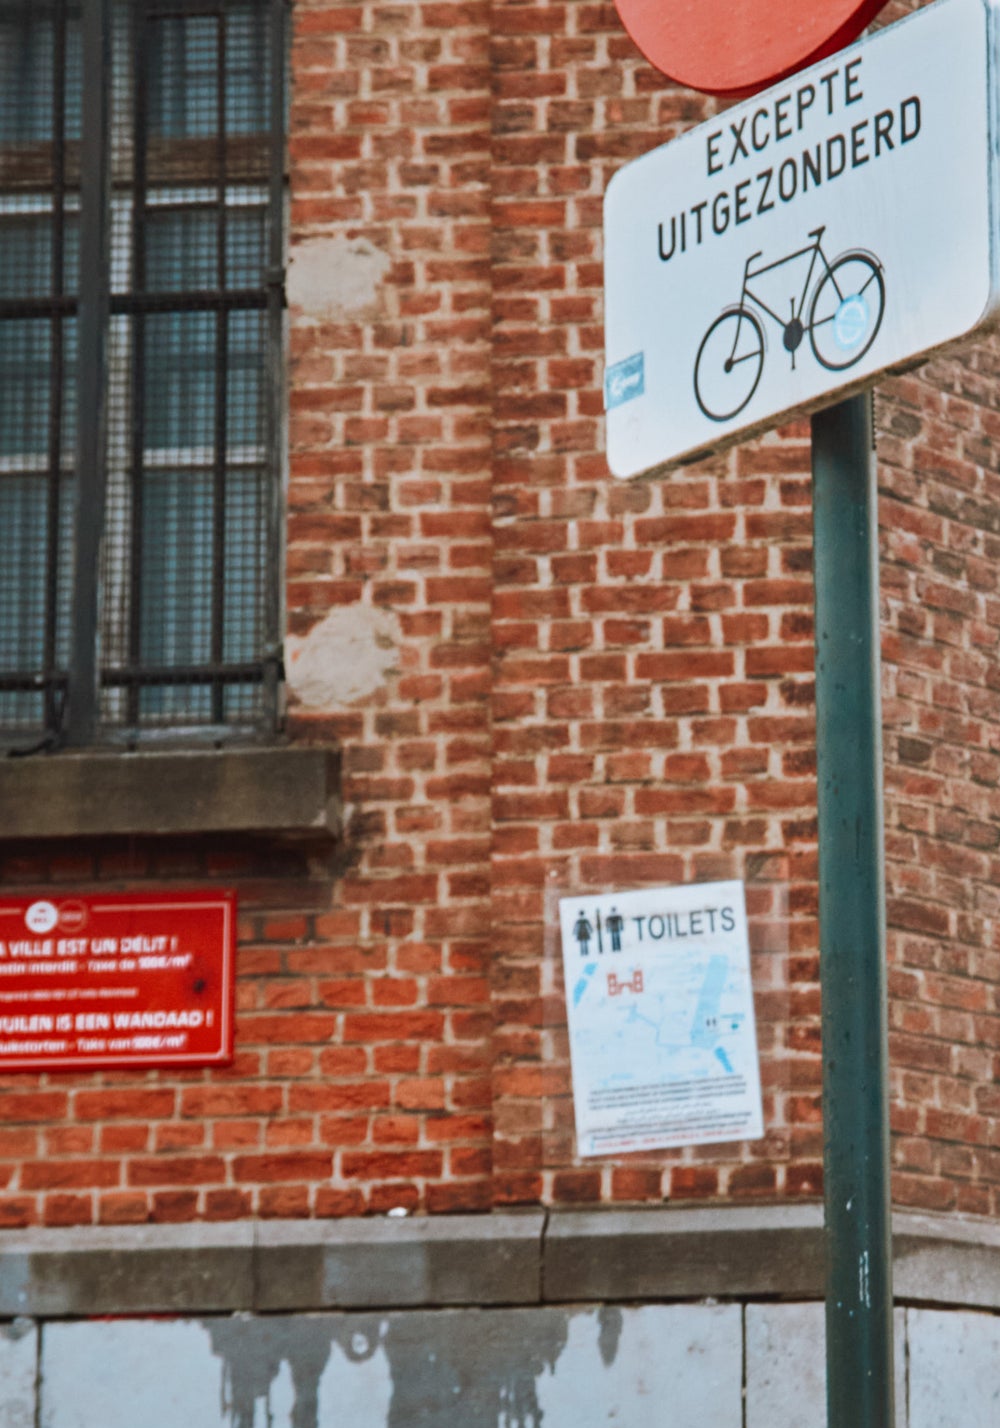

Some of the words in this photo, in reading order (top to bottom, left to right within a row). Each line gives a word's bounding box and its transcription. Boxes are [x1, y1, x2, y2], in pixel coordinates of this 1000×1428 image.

[705, 56, 864, 177] EXCEPTE
[657, 95, 922, 262] UITGEZONDERD
[631, 905, 737, 942] TOILETS
[8, 938, 53, 957] VILLE
[57, 937, 88, 956] EST
[90, 937, 118, 955] UN
[0, 1013, 53, 1034] UILEN
[75, 1012, 109, 1031] EEN
[113, 1009, 204, 1029] WANDAAD
